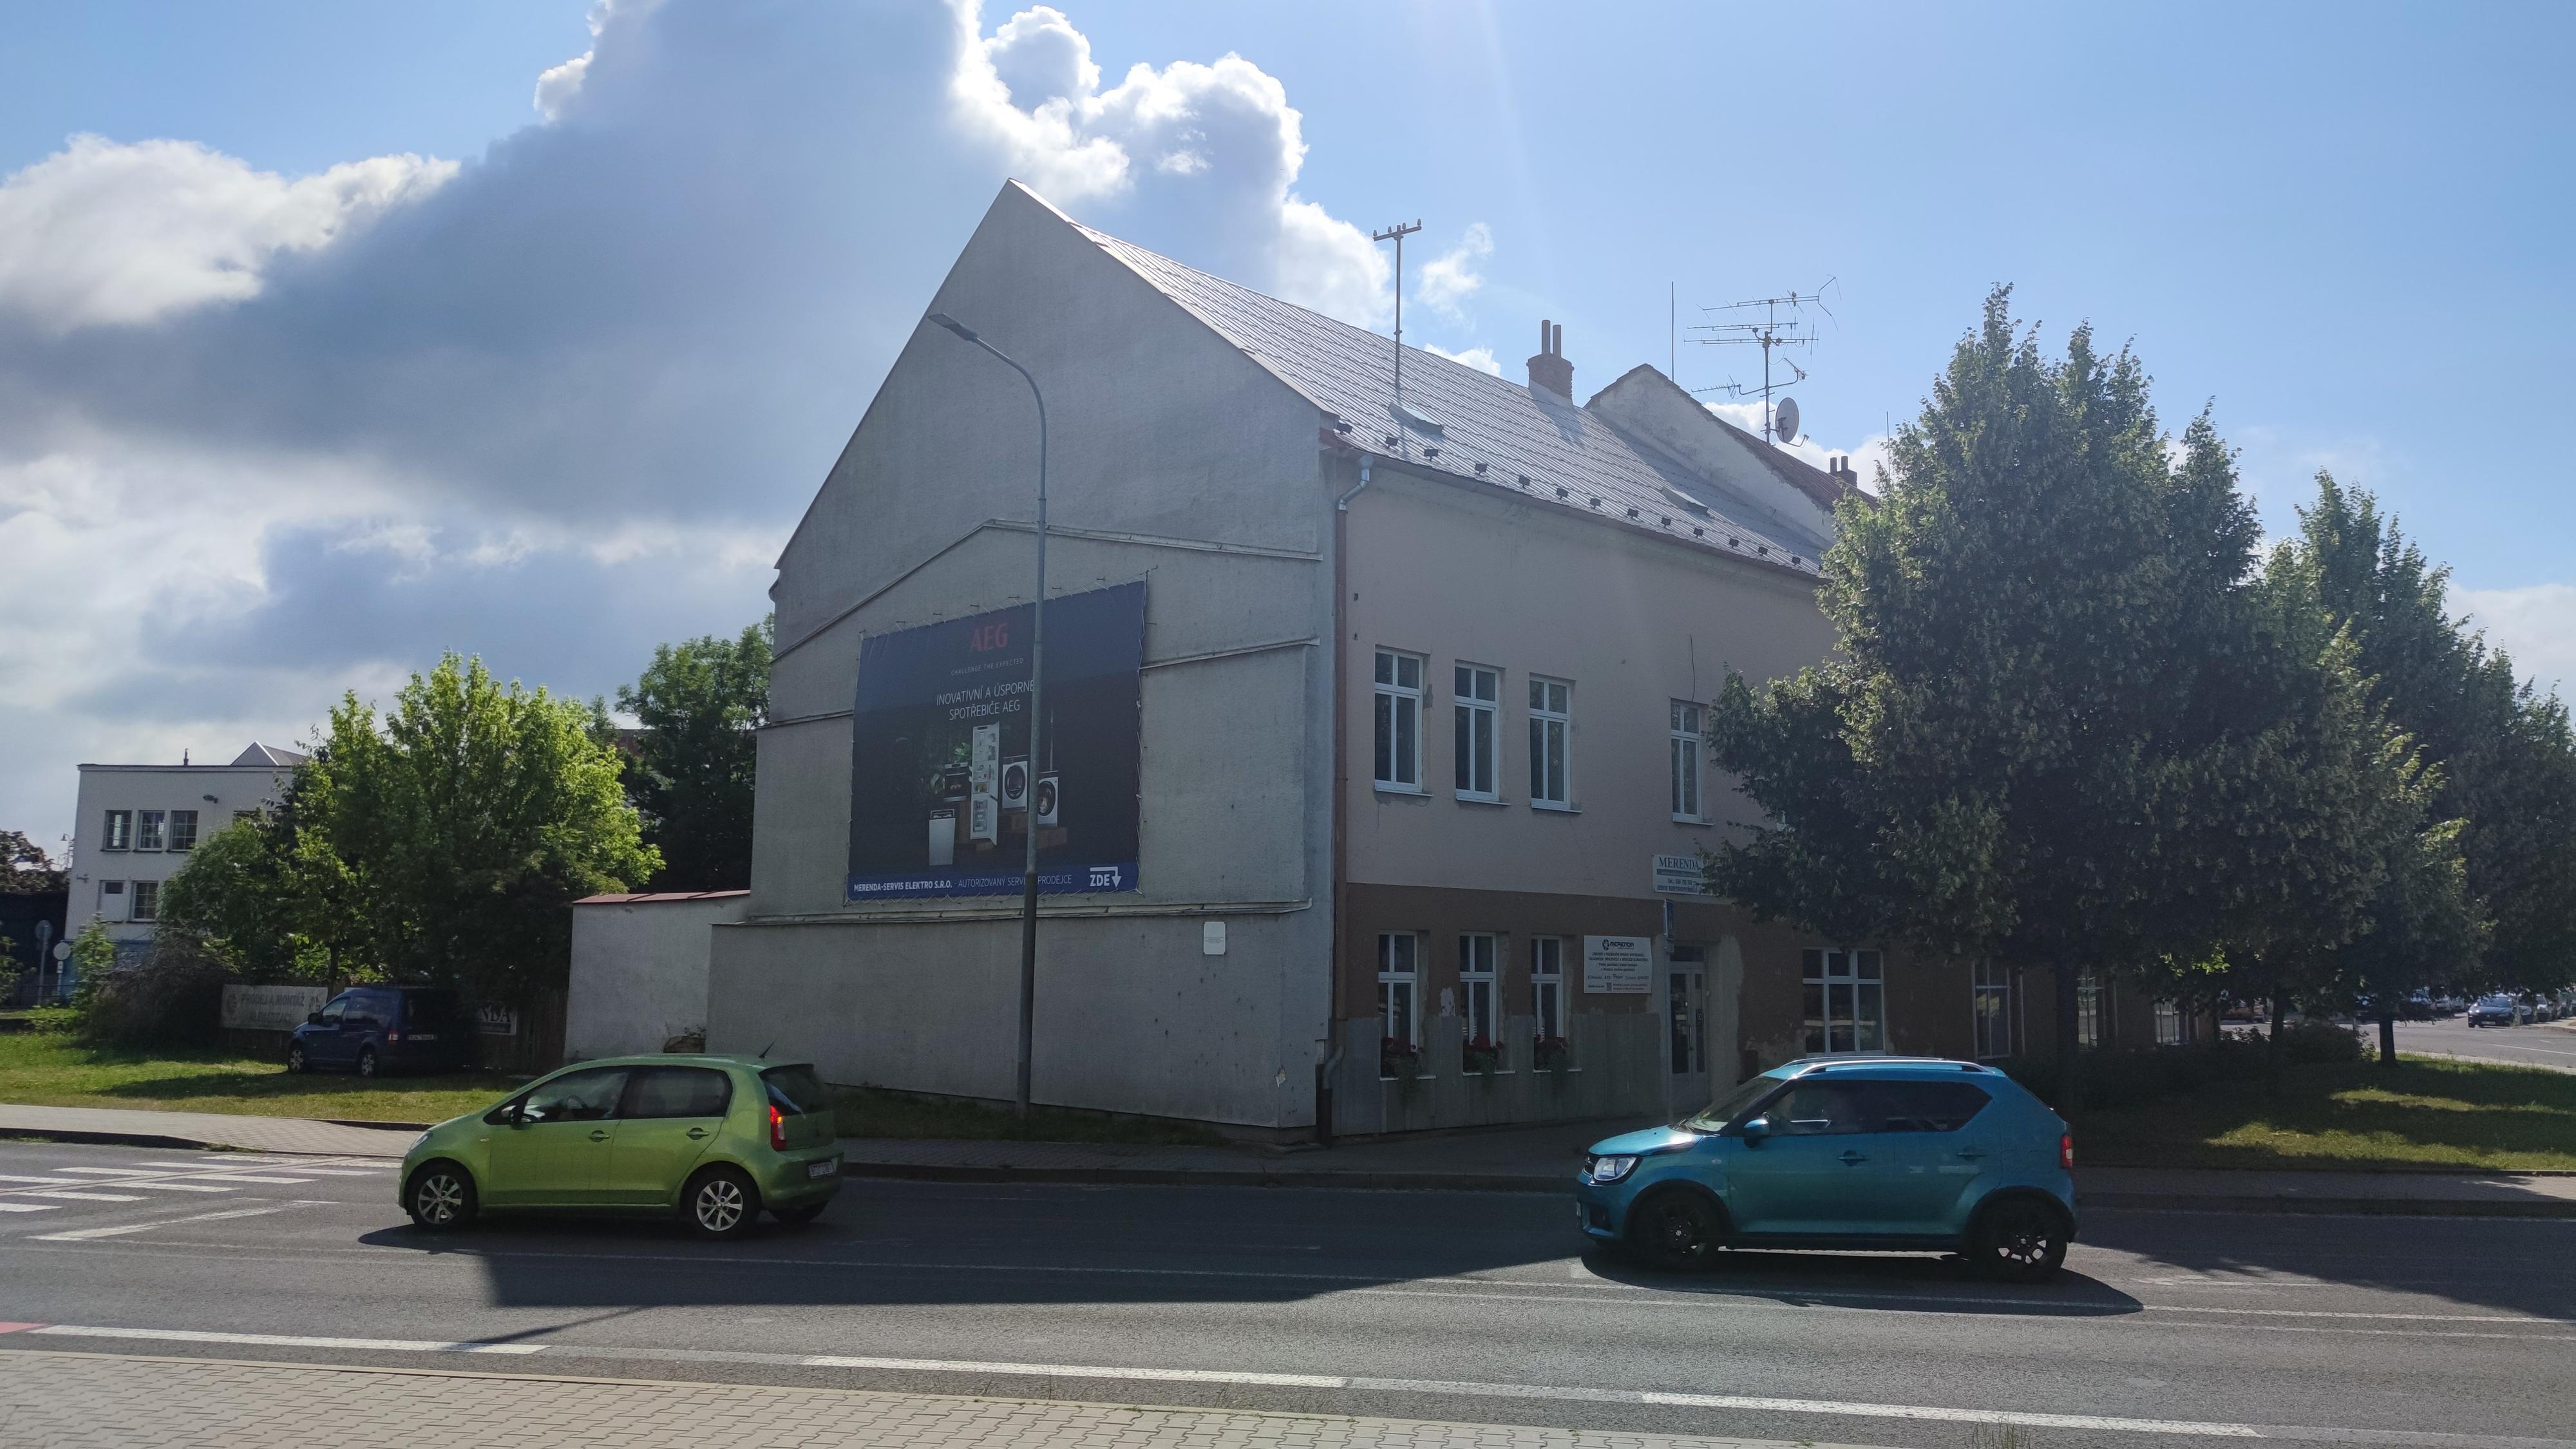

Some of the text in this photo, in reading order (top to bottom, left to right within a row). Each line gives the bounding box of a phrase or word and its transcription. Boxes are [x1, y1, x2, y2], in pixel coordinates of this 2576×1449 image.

[971, 623, 1009, 651] AEG
[951, 658, 1025, 676] CHALLENGE THE EXPECTED
[936, 685, 983, 706] INOVATIVNÍ
[985, 687, 992, 698] A
[949, 699, 1021, 721] SPOTŘEBIČE AEG
[1659, 857, 1700, 871] MERENDA
[854, 882, 904, 892] MERENDA-SERVIS
[905, 880, 933, 890] ELEKTRO
[934, 880, 952, 889] S.R.O.
[958, 875, 1006, 888] AUTORIZOVANÝ
[1007, 876, 1026, 887] SERVI
[1037, 875, 1072, 886] PRODEJCE
[1089, 873, 1110, 887] ZDE
